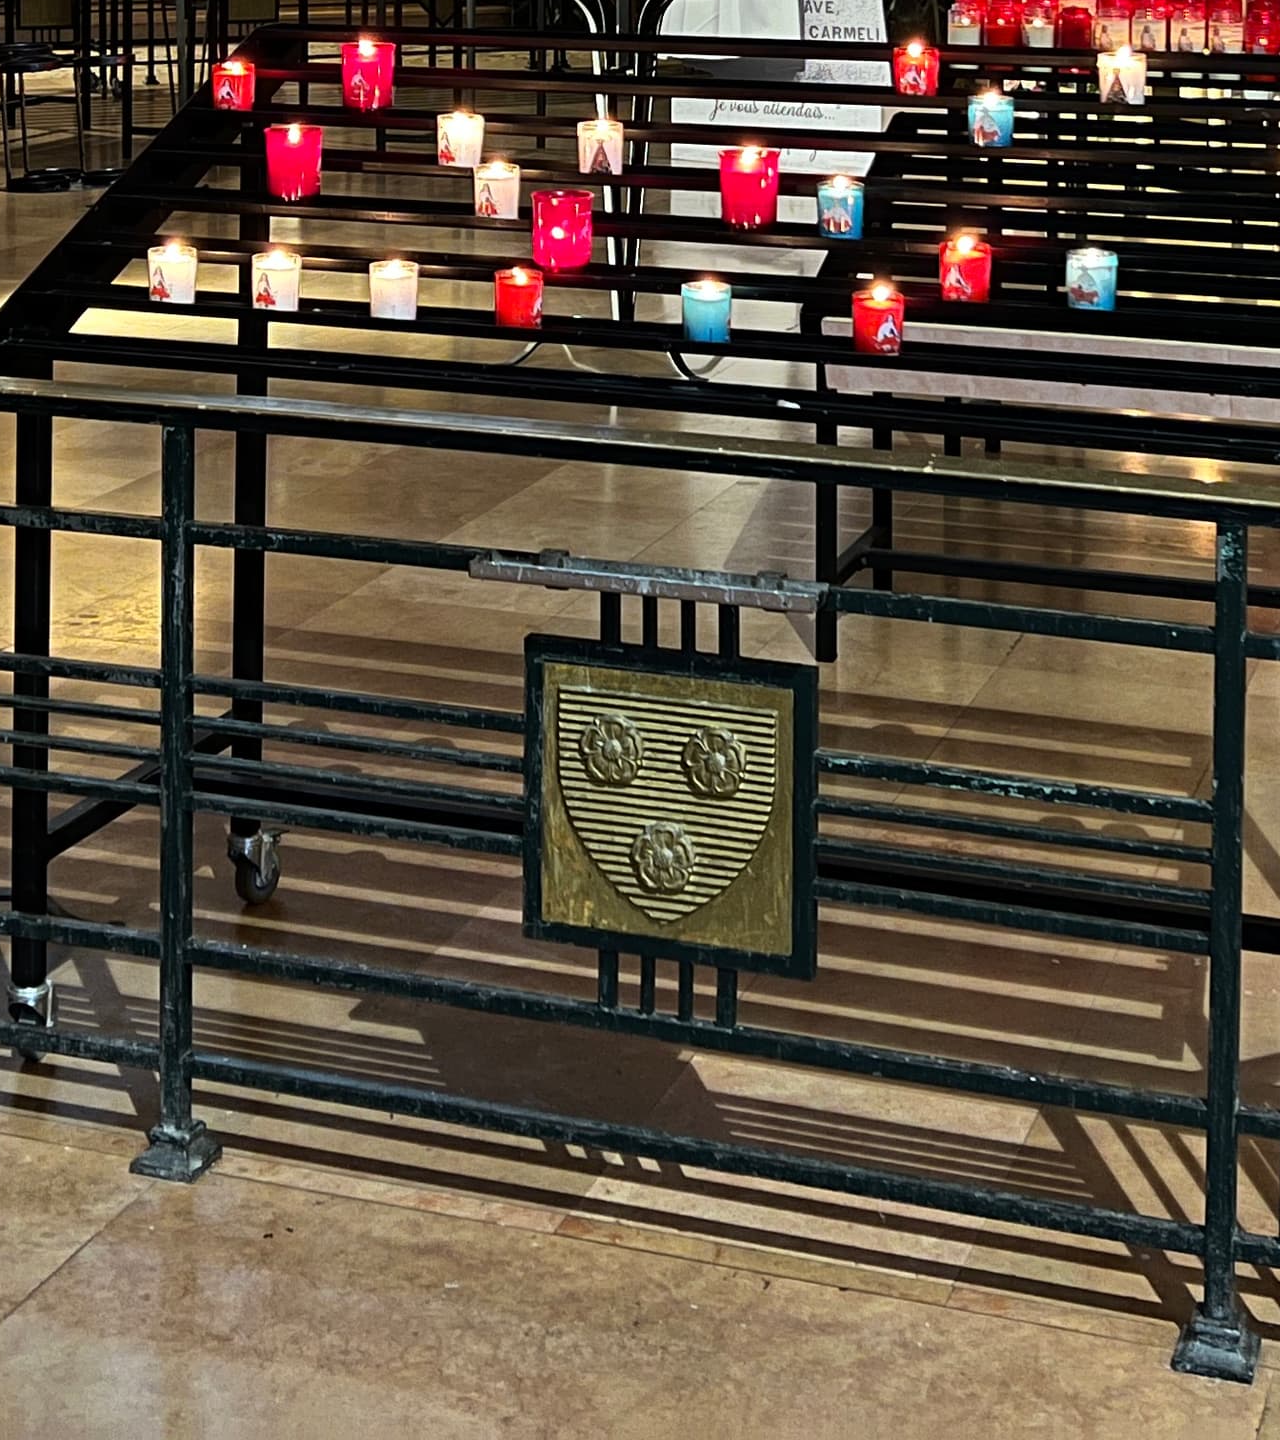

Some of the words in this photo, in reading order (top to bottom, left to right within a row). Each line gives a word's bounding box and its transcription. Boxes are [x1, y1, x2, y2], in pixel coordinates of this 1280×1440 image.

[804, 0, 840, 16] AVE,
[809, 25, 880, 41] CARMELI
[710, 99, 726, 121] Je
[730, 100, 759, 114] vous
